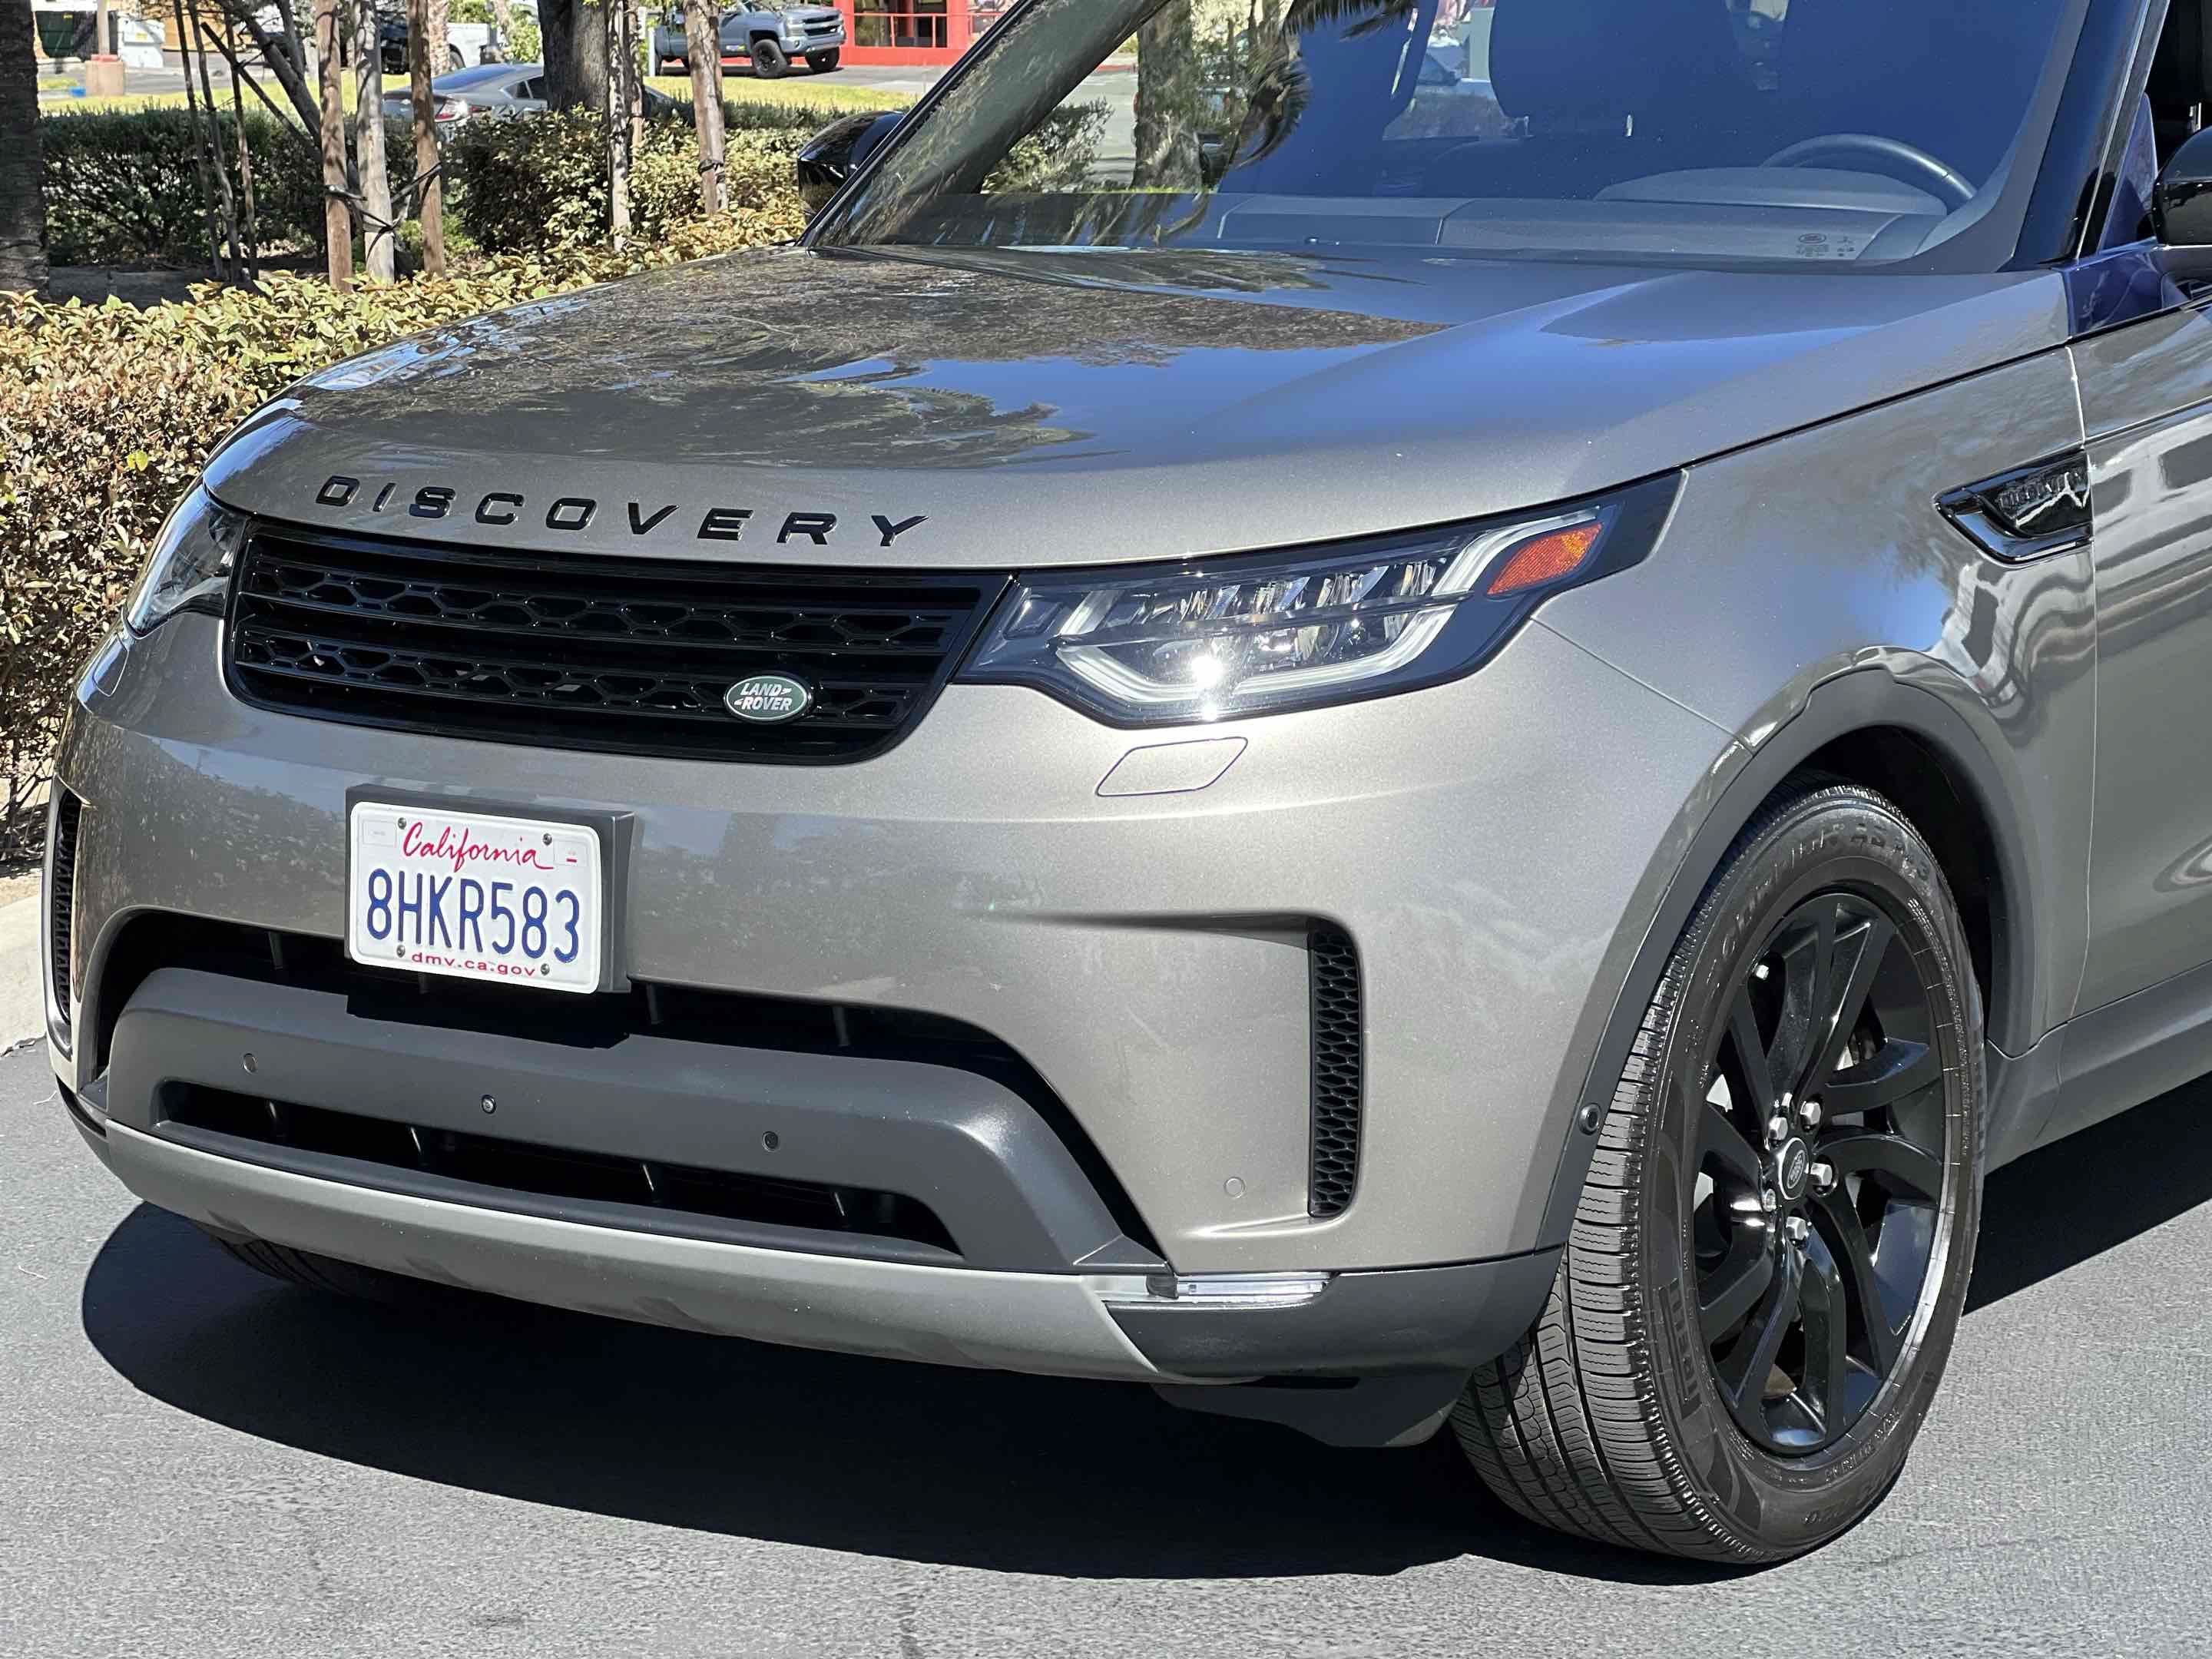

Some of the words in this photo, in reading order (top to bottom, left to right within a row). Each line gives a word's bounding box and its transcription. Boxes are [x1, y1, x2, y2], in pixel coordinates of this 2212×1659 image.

[316, 475, 930, 547] DISCOVERY
[740, 683, 782, 696] LAND
[741, 696, 793, 711] ROVER
[402, 822, 554, 873] California
[367, 868, 580, 964] 8HKR583
[412, 952, 535, 976] dmv.ca.gov
